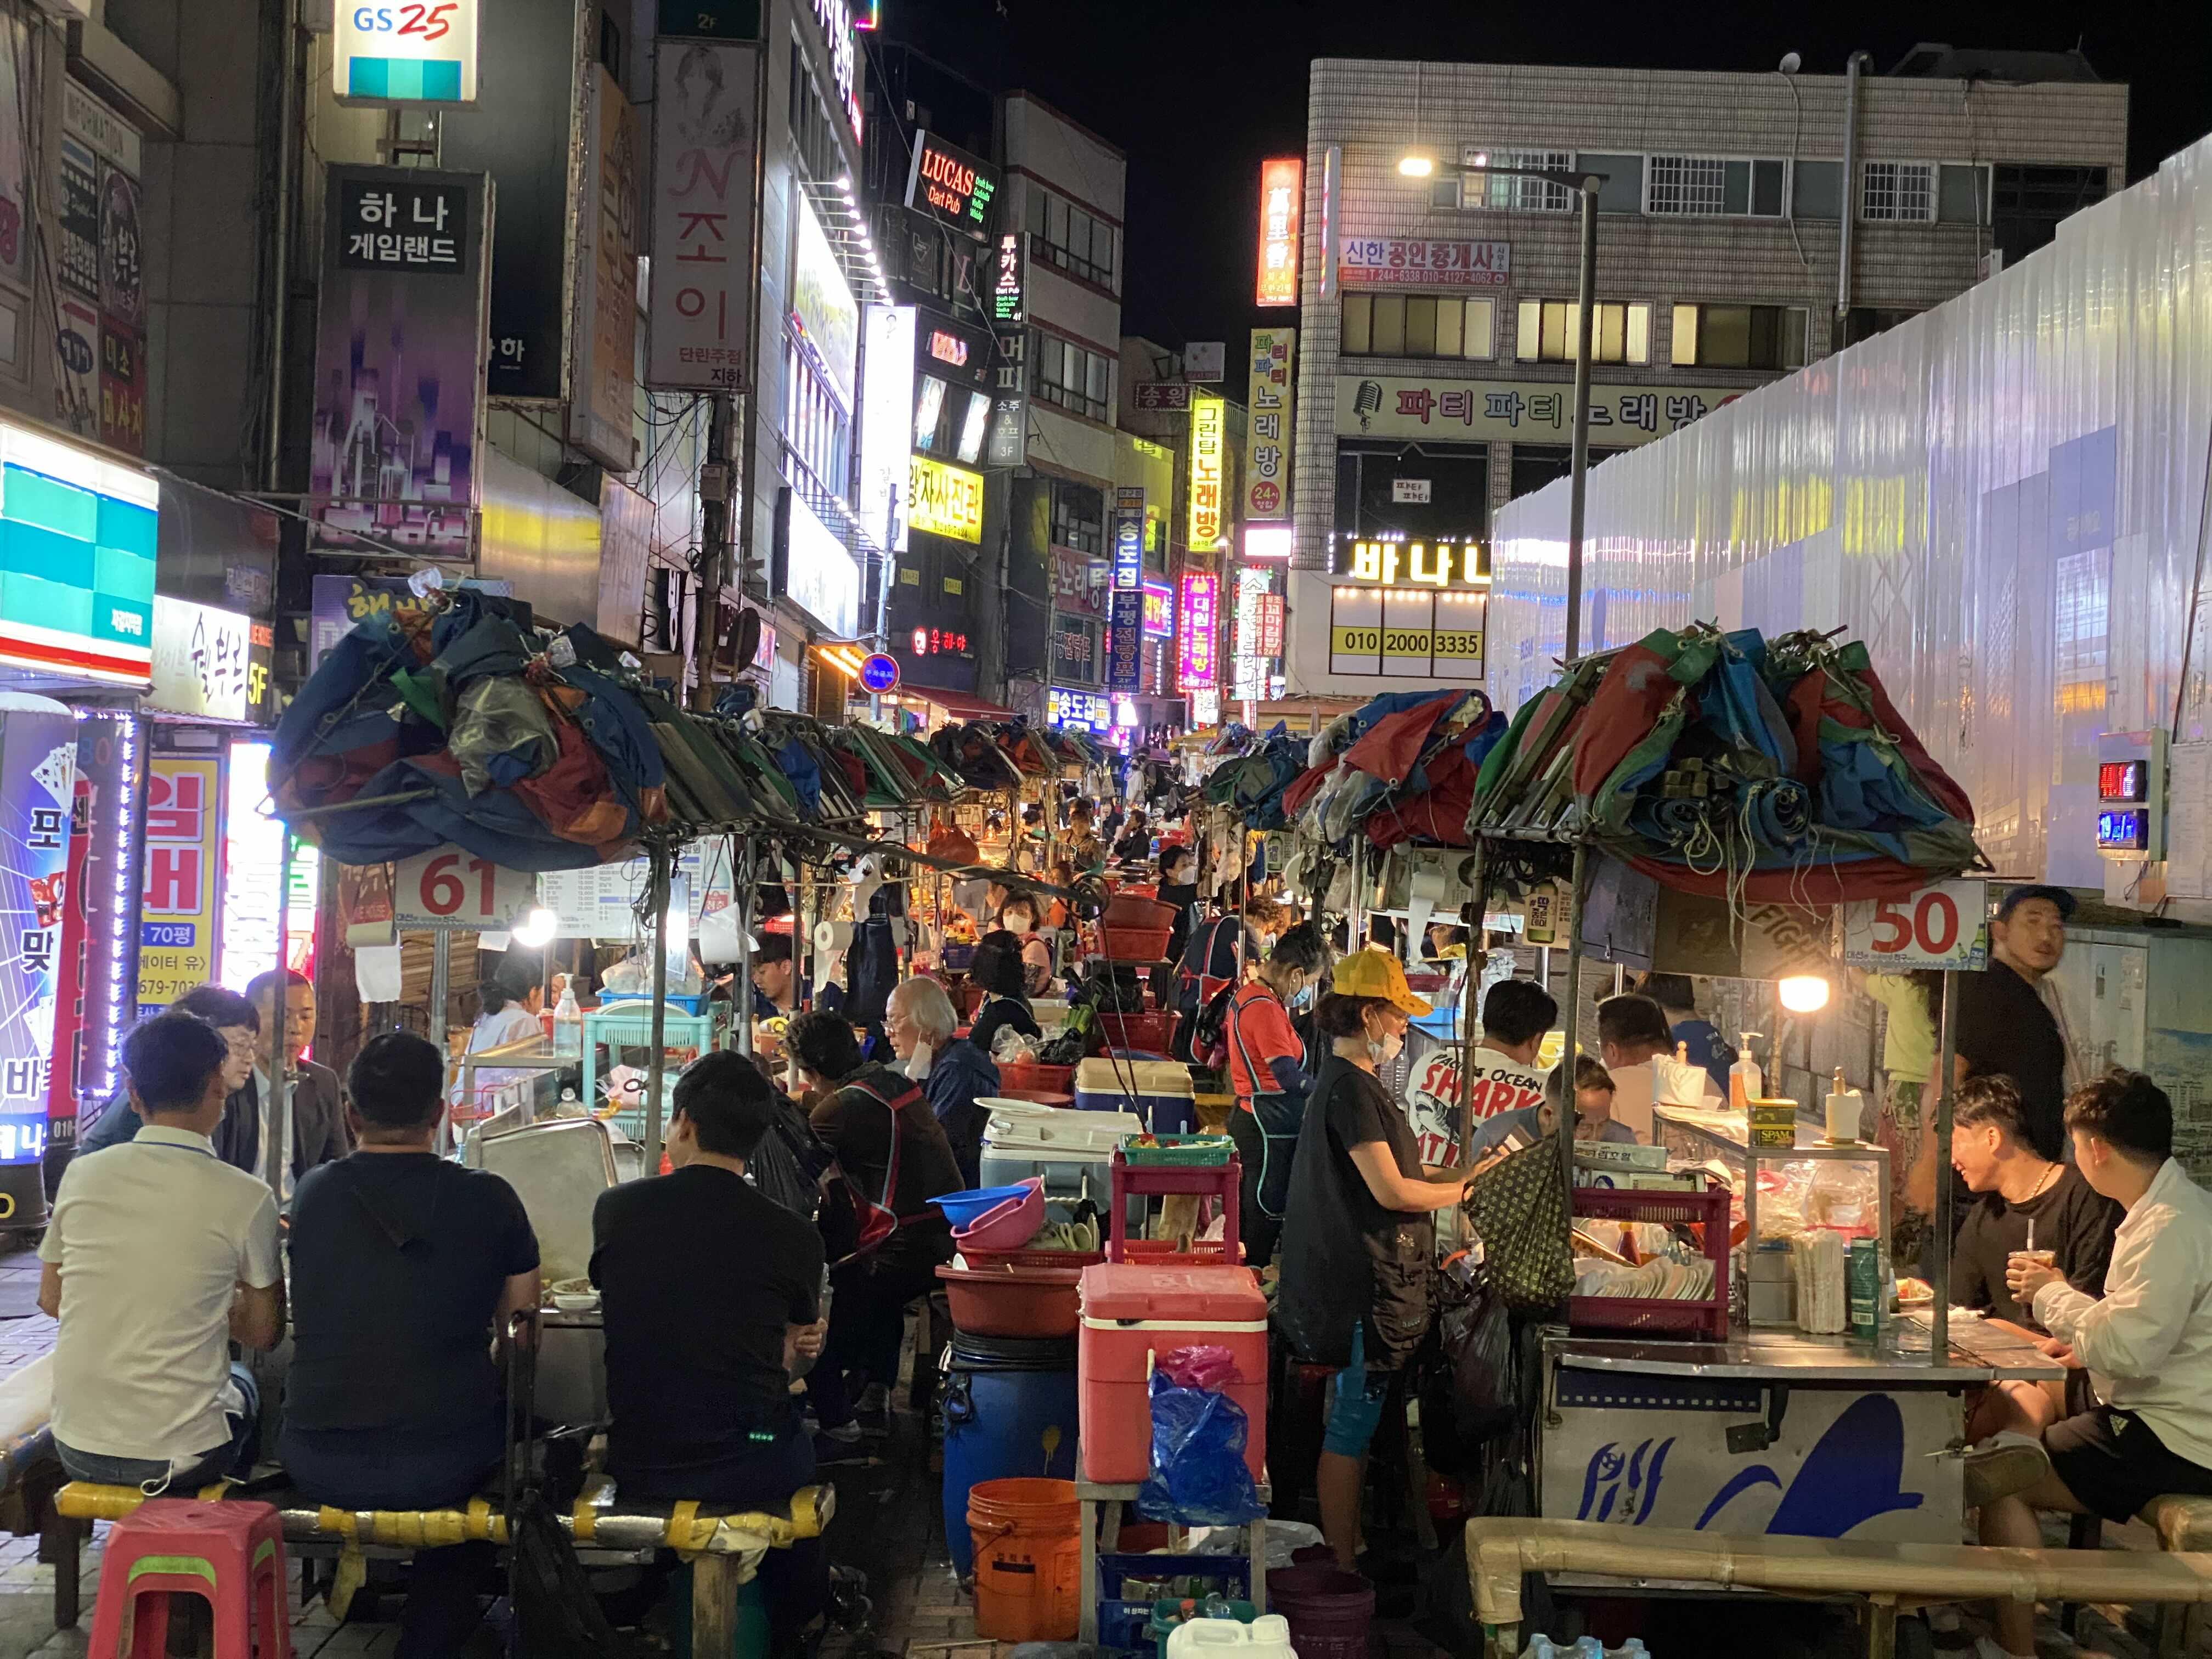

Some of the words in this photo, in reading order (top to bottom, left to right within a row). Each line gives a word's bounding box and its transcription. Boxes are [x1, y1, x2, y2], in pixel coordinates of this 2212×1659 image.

[922, 149, 974, 196] LUCAS
[928, 186, 945, 207] Dart
[945, 193, 961, 215] Pub
[348, 233, 457, 263] 게임랜드
[1001, 234, 1017, 286] 루카스
[1346, 241, 1384, 266] 신한
[1388, 242, 1494, 270] 공인중개사
[711, 368, 742, 385] 지하
[996, 400, 1019, 411] 소주
[1395, 387, 1474, 426] 파티
[1484, 391, 1562, 430] 파티
[1198, 407, 1216, 455] 그린탑
[1254, 386, 1282, 477] 노래방
[1000, 447, 1014, 456] 3F
[1196, 459, 1217, 538] 노래방
[1117, 521, 1139, 586] 송도집
[1345, 632, 1378, 650] 010
[1386, 634, 1429, 651] 2000
[1436, 635, 1478, 653] 3335
[247, 662, 268, 704] 5F
[1059, 691, 1096, 722] 송도집
[420, 854, 496, 916] 61
[150, 927, 191, 945] 70평
[1871, 892, 1959, 954] 50
[1420, 1064, 1542, 1119] SHARK
[1491, 1069, 1543, 1092] OCEAN
[1762, 1130, 1789, 1139] SPAM
